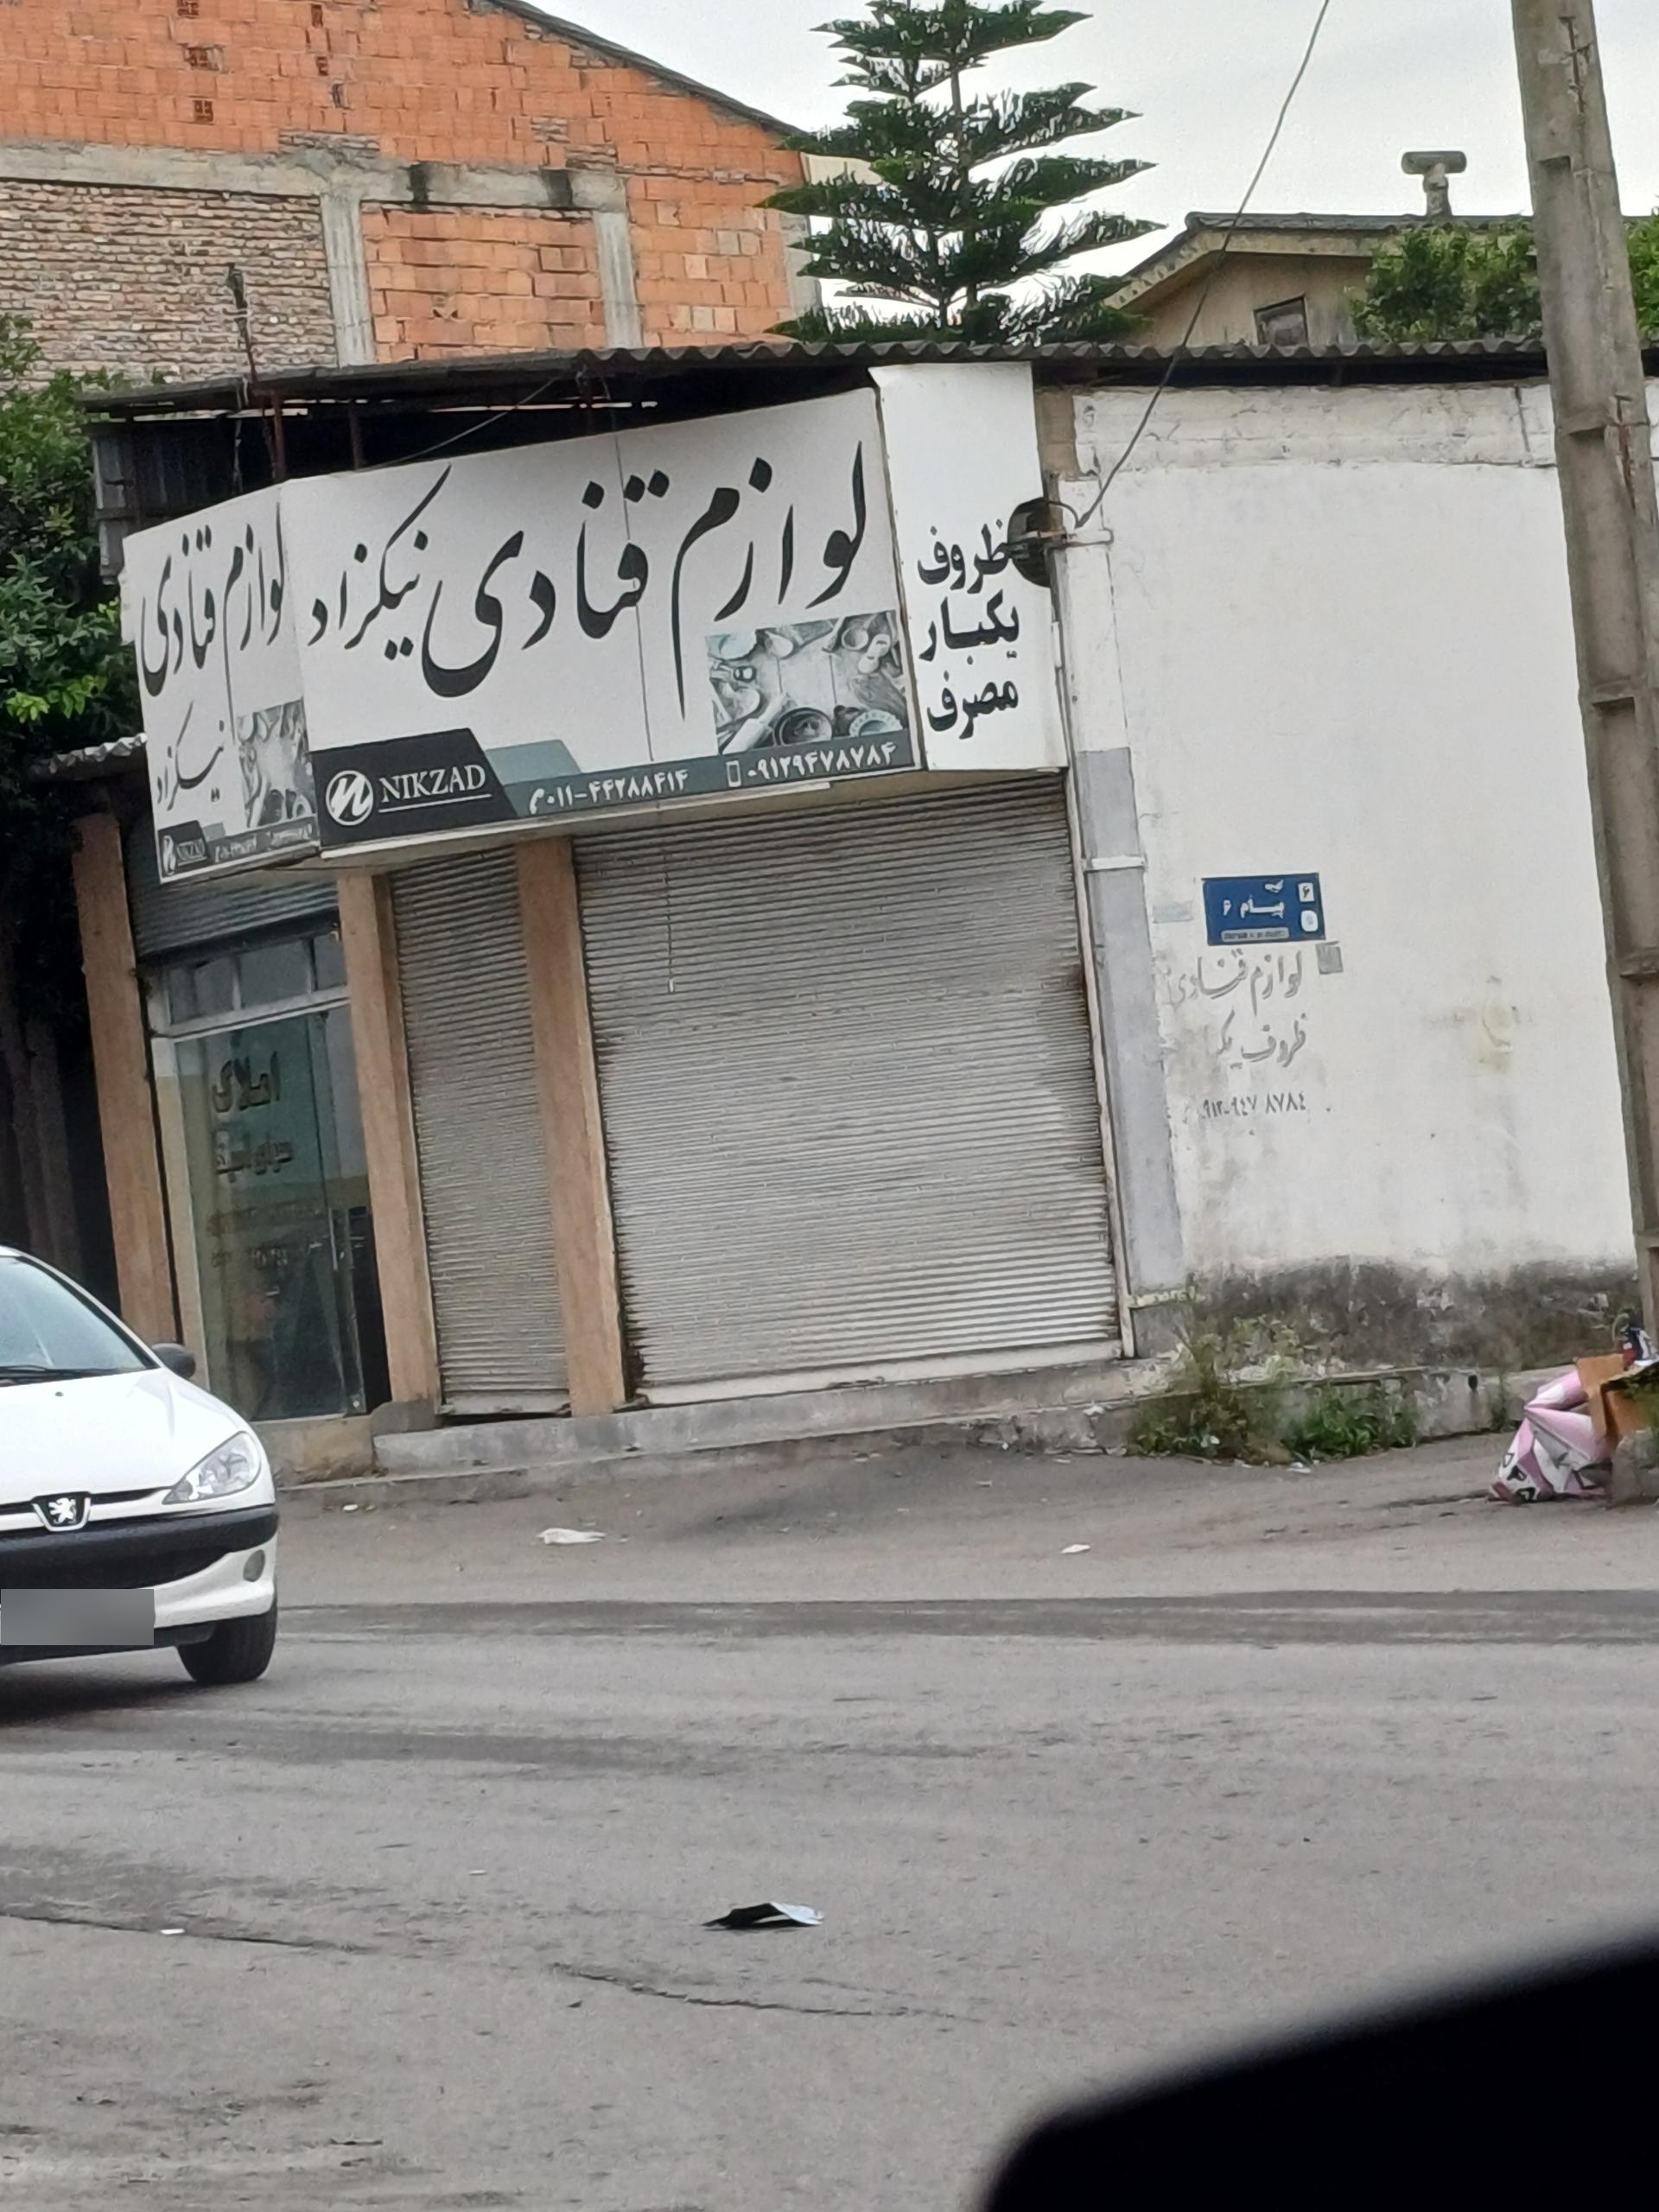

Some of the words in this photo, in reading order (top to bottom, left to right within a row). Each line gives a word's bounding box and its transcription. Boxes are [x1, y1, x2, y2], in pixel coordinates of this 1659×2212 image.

[142, 524, 215, 697] قنادی
[307, 462, 452, 660] نیکزاد
[422, 469, 670, 697] قنادی
[671, 441, 866, 721] لوازم
[918, 518, 1012, 594] ظروف
[223, 501, 284, 745] لوازم
[918, 589, 1020, 665] یکبار
[156, 701, 225, 812] نیکزاد
[926, 671, 1020, 740] مصرف
[379, 763, 487, 803] NIKZAD
[1250, 950, 1302, 1017] لوازم
